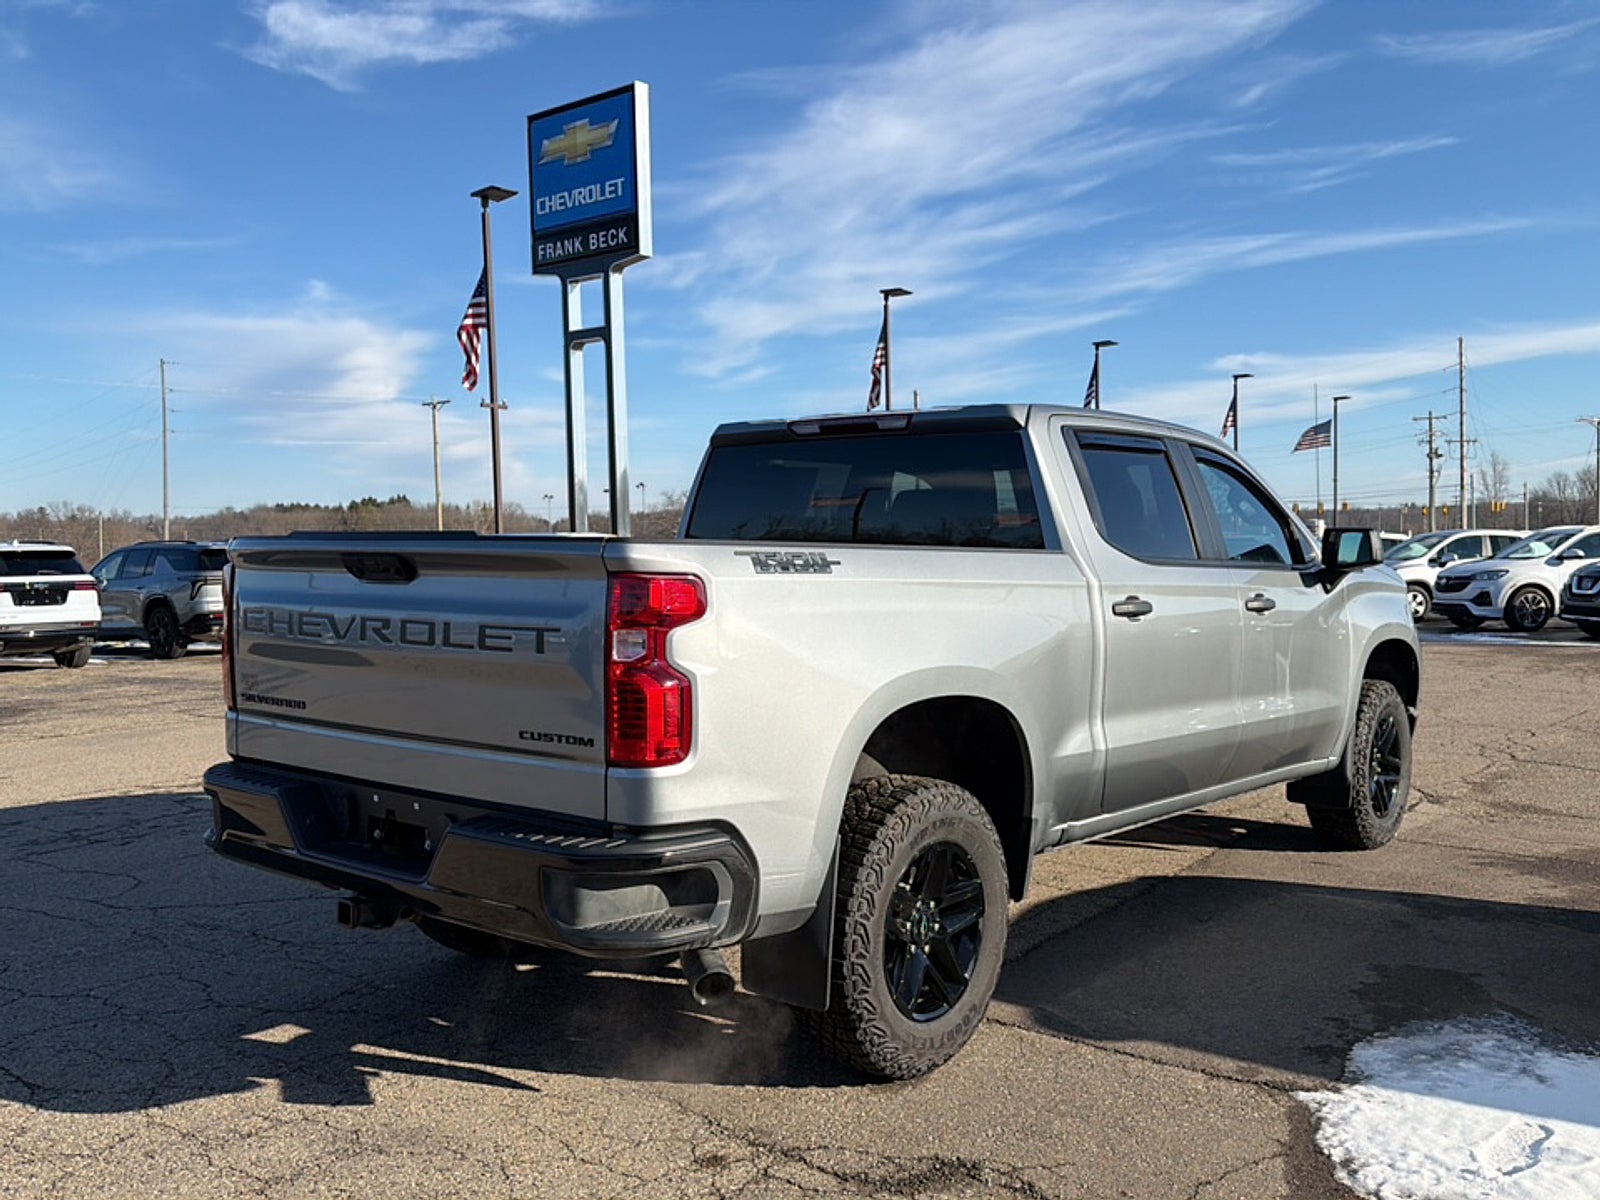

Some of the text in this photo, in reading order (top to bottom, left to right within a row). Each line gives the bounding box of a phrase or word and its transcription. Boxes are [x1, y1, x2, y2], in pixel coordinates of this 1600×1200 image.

[537, 177, 625, 215] CHEVROLET
[537, 226, 628, 261] FRANK BECK
[243, 607, 561, 655] CHEVROLET
[241, 693, 306, 710] SILVERADO
[518, 730, 595, 748] CUSTOM
